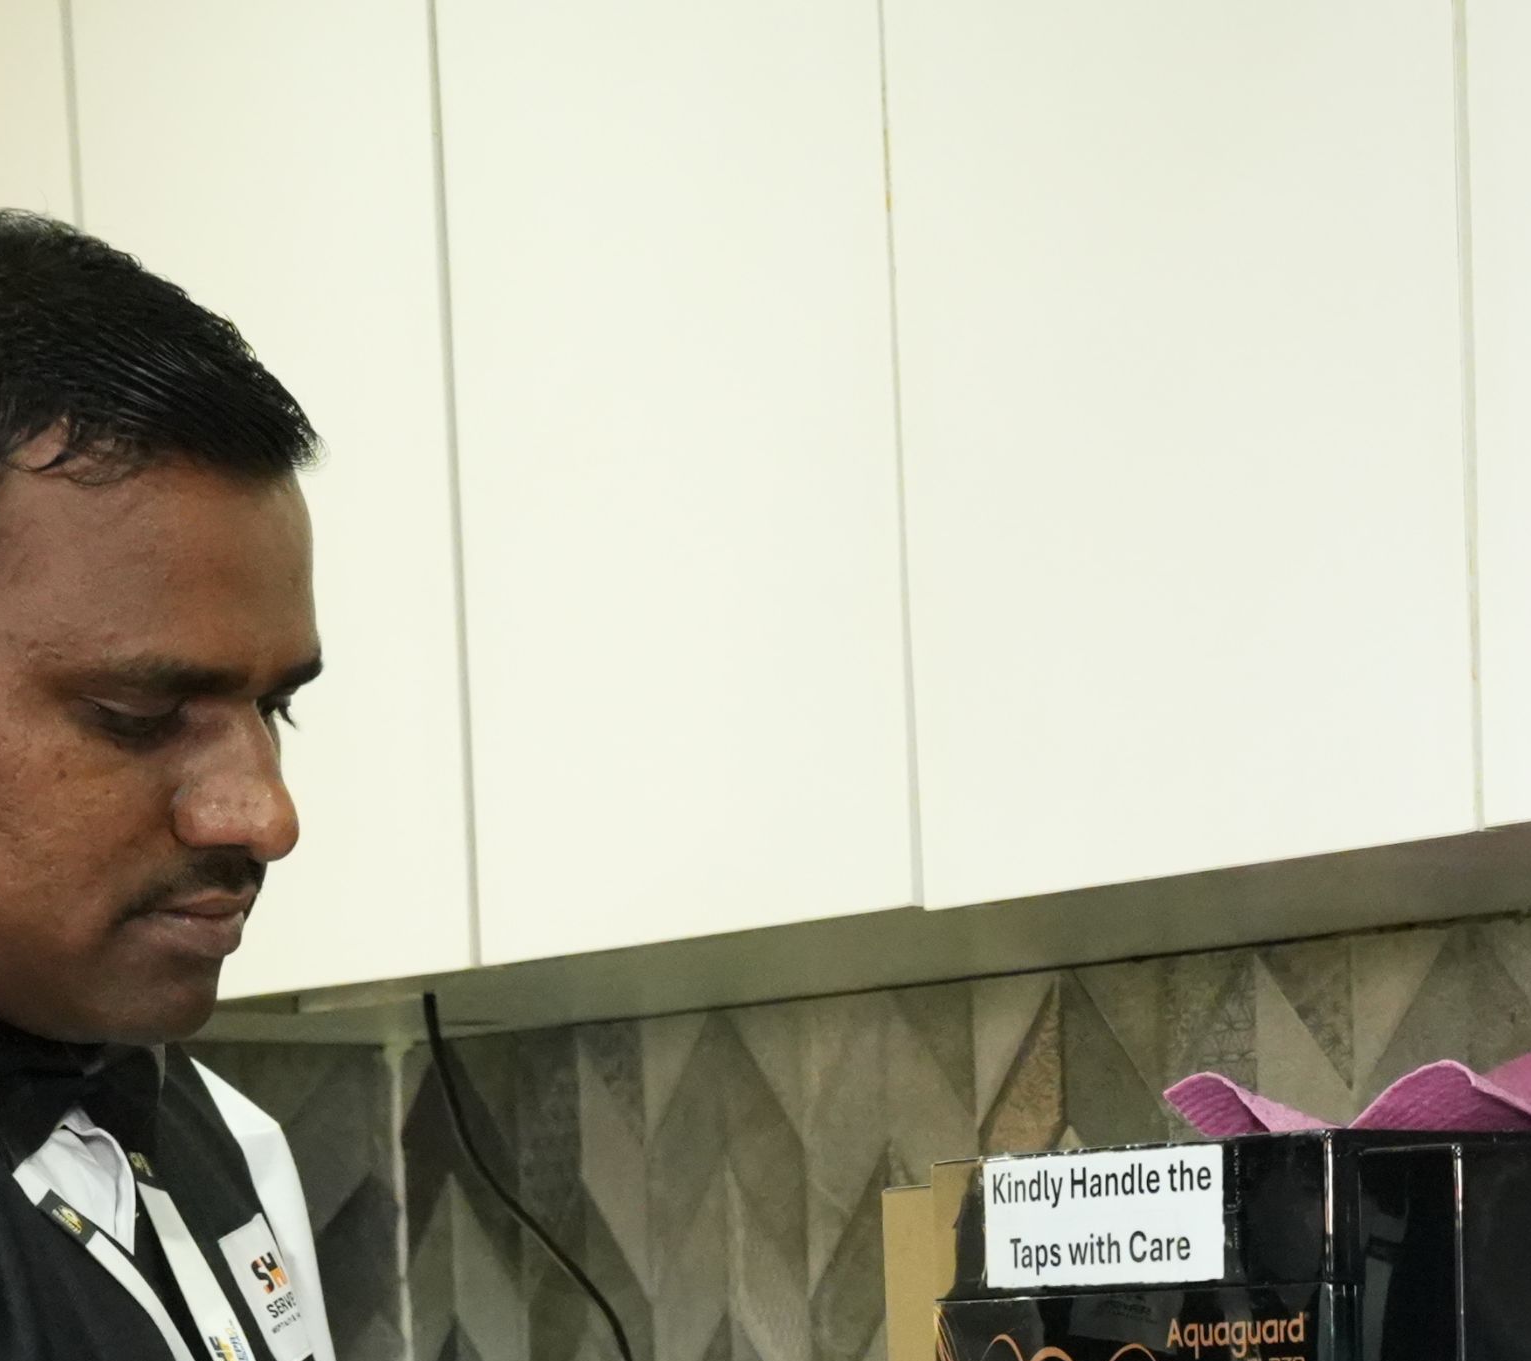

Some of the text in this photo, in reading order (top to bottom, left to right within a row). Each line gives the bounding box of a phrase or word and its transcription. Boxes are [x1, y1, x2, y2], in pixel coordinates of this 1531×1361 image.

[992, 1160, 1212, 1208] Kindly Handle the
[1010, 1230, 1191, 1275] Taps with Care
[1166, 1311, 1305, 1360] Aquaguard
